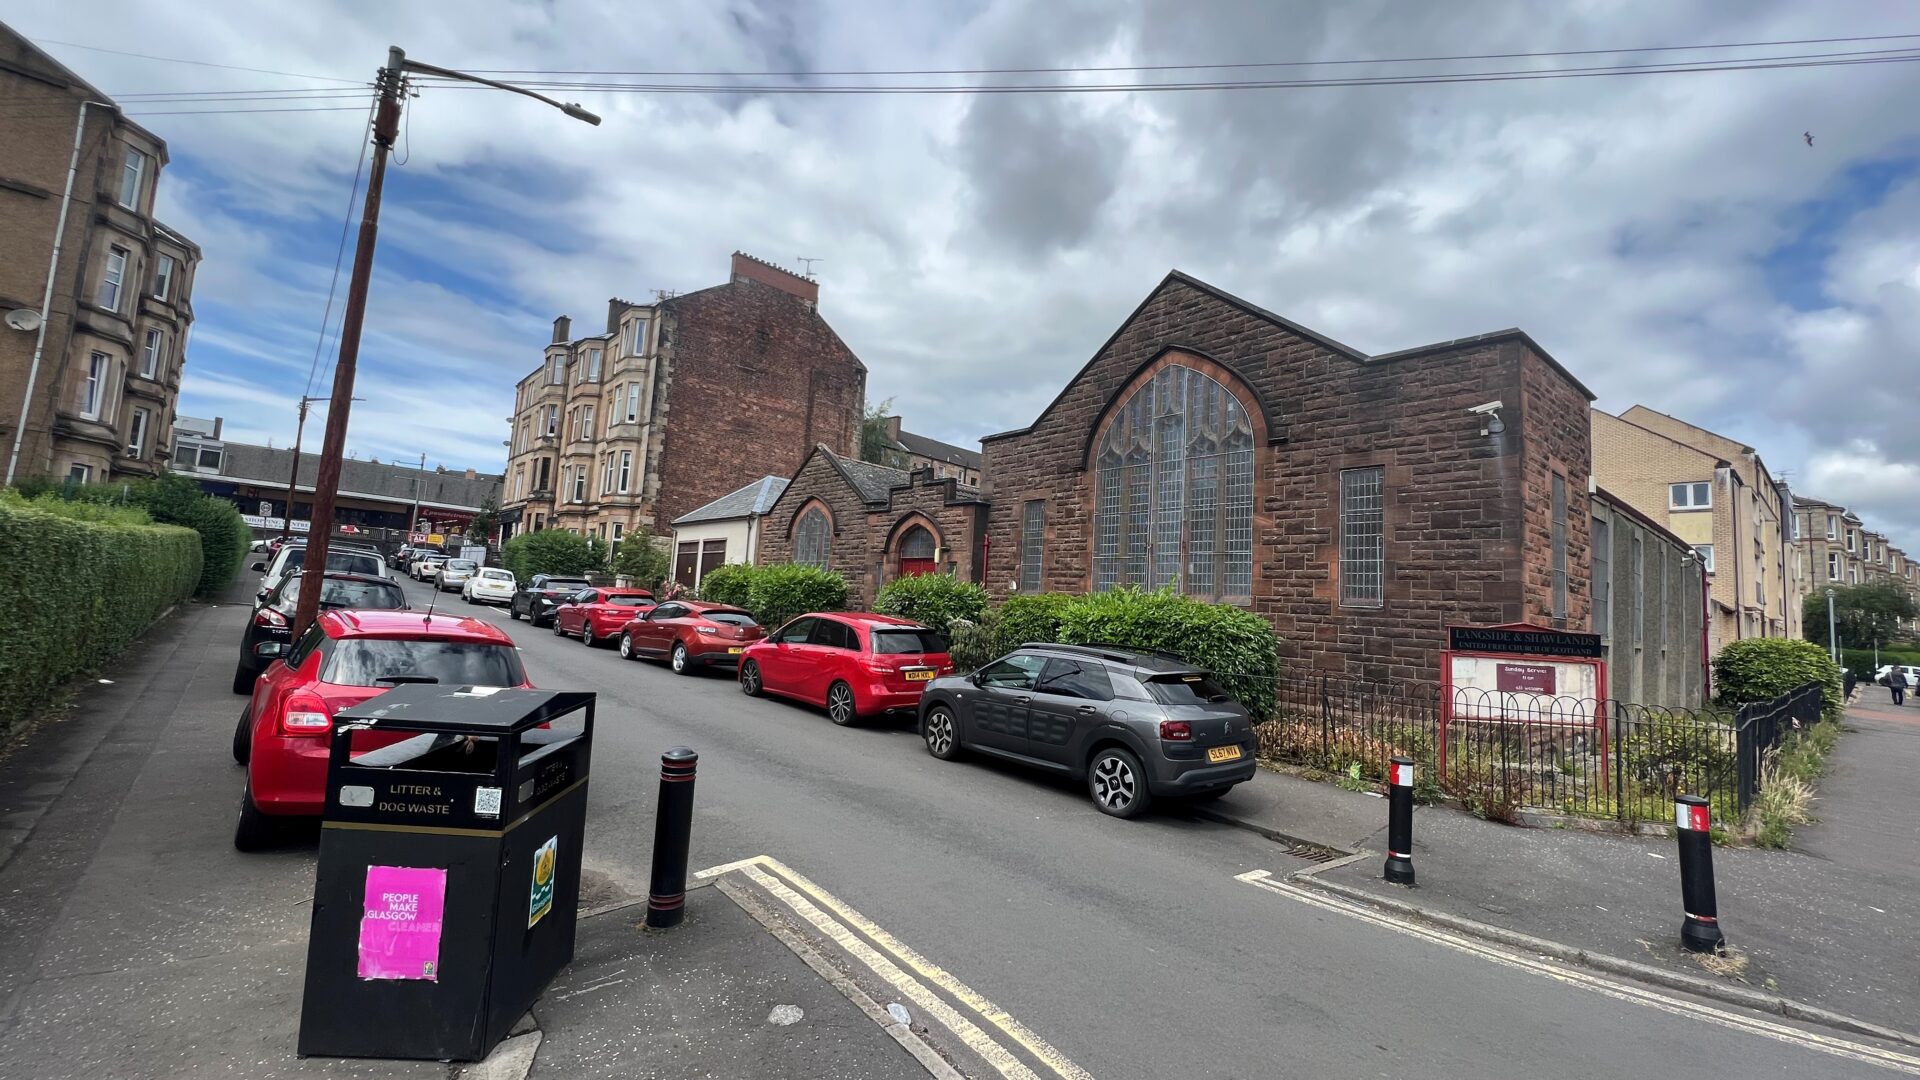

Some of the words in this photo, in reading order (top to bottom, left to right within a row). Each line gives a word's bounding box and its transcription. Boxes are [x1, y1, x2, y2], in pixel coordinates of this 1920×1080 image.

[1456, 630, 1511, 642] LANGSIDE
[1524, 634, 1596, 646] SHAWLANDS
[390, 784, 431, 795] LITTER
[433, 786, 442, 796] &
[379, 802, 406, 812] DOG
[408, 803, 450, 814] WASTE
[383, 892, 419, 902] PEOPLE
[389, 902, 418, 912] MAKE
[367, 910, 417, 920] GLASGOW
[388, 922, 440, 933] CLEANER
